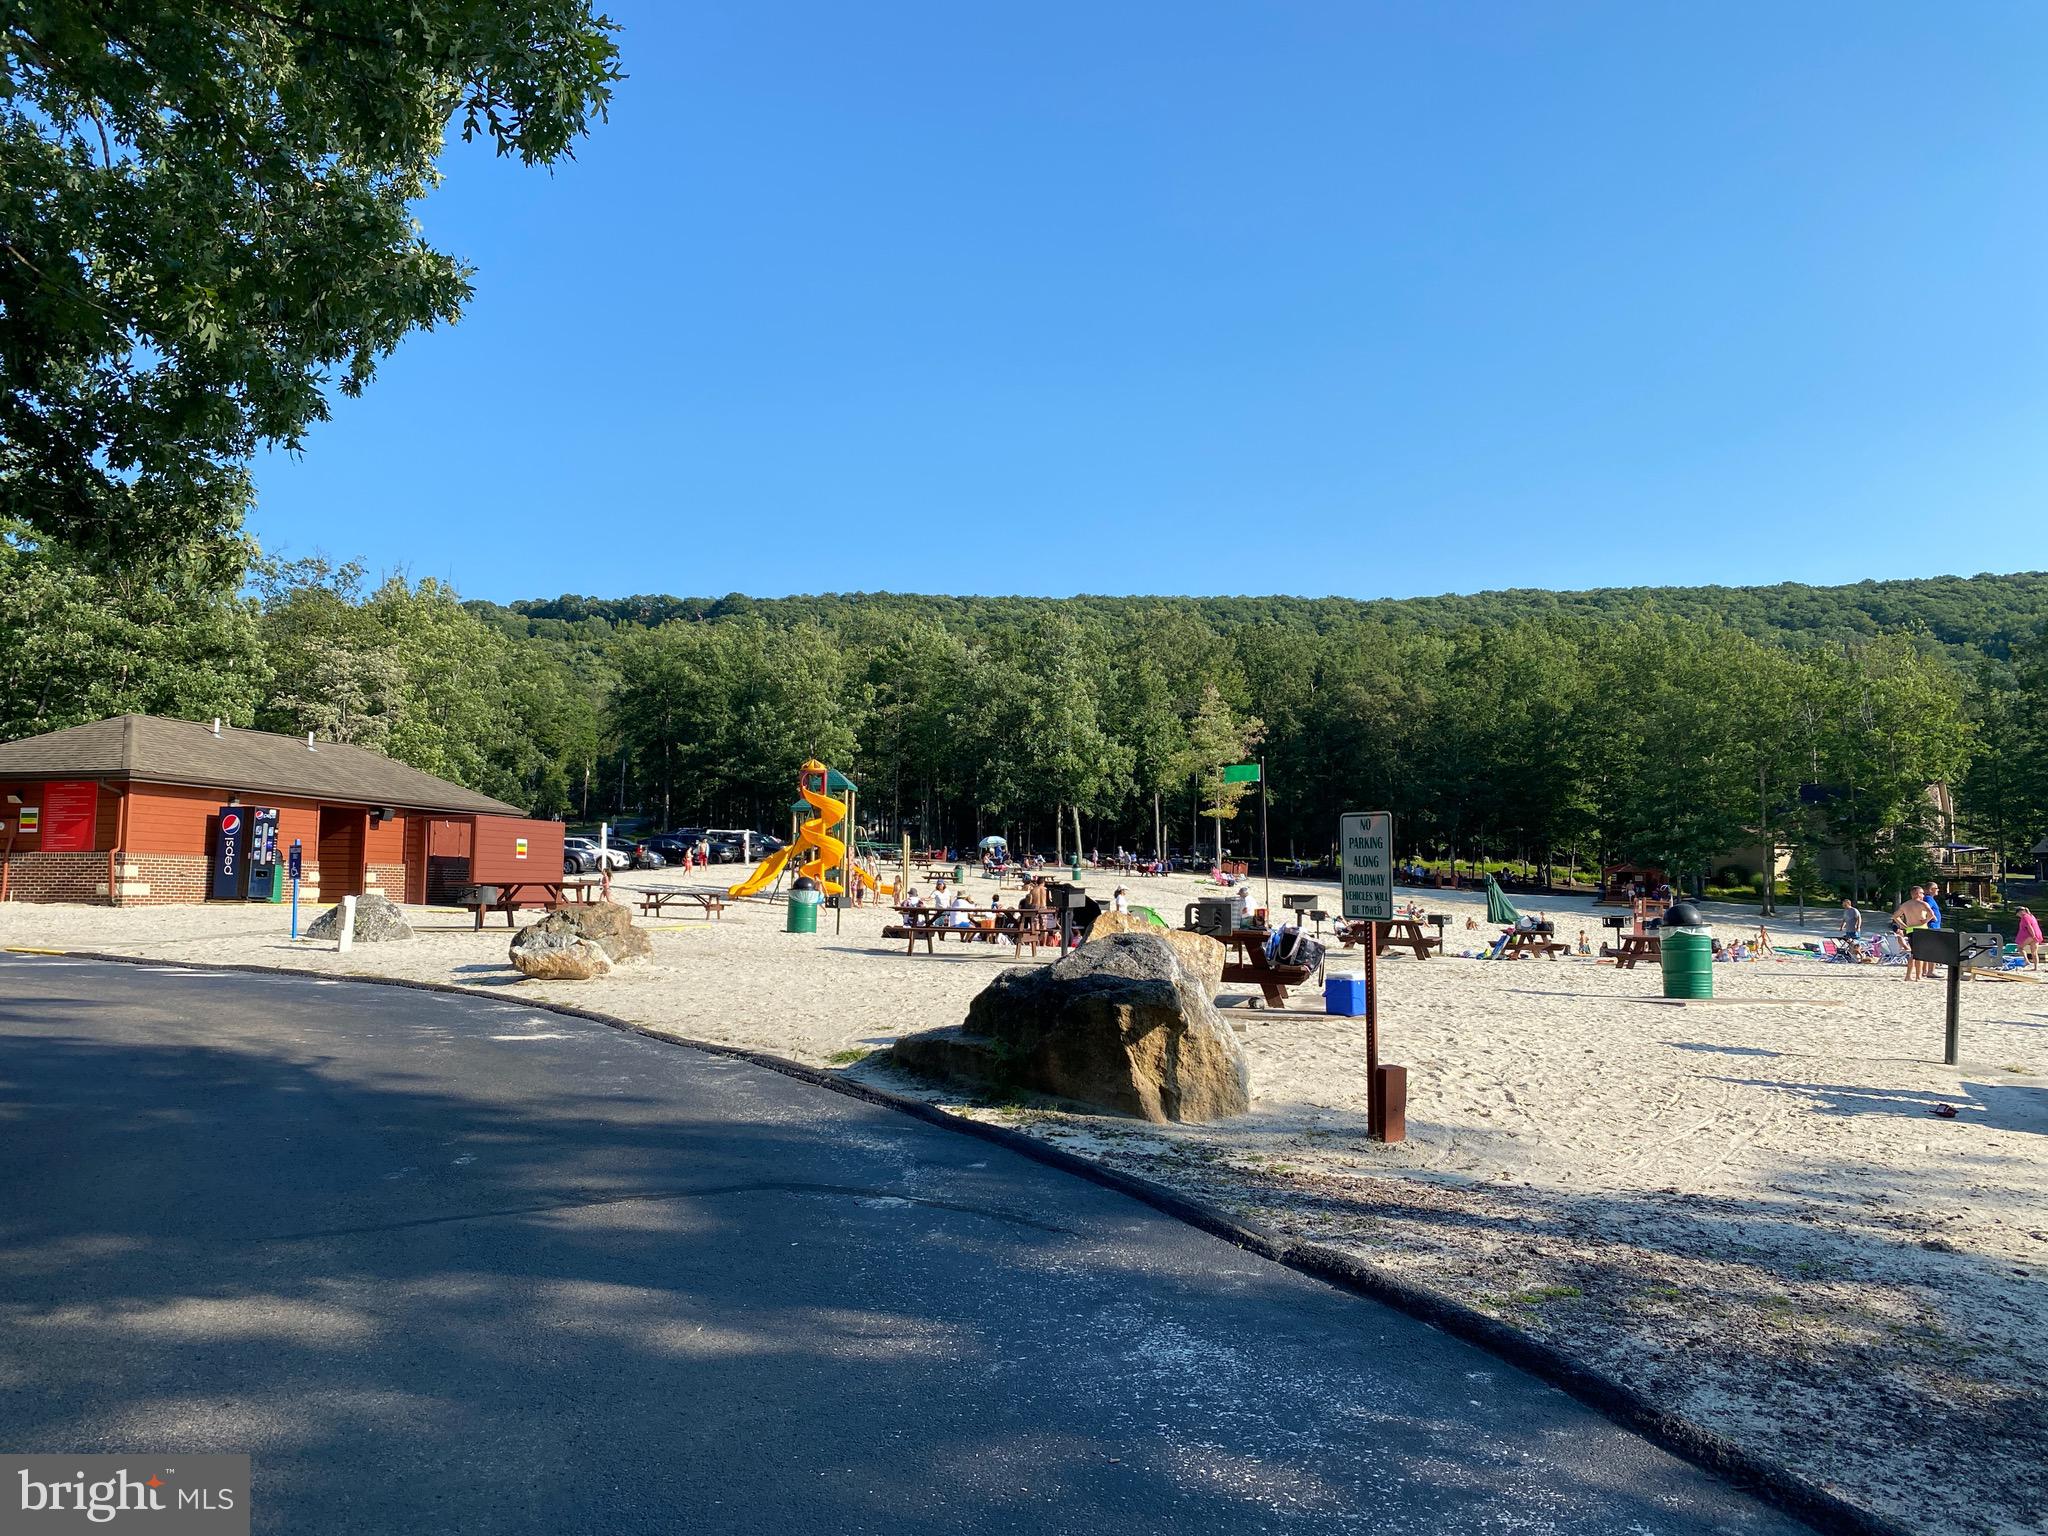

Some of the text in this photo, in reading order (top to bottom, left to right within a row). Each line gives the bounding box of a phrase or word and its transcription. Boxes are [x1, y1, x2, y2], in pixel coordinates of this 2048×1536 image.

[1360, 818, 1371, 831] NO
[1349, 836, 1384, 849] PARKING
[223, 837, 235, 875] pepsi
[1353, 855, 1379, 868] ALONG
[1348, 873, 1385, 887] ROADWAY
[1345, 890, 1388, 902] VEHICLES WILL
[1352, 904, 1382, 916] BE TOWED
